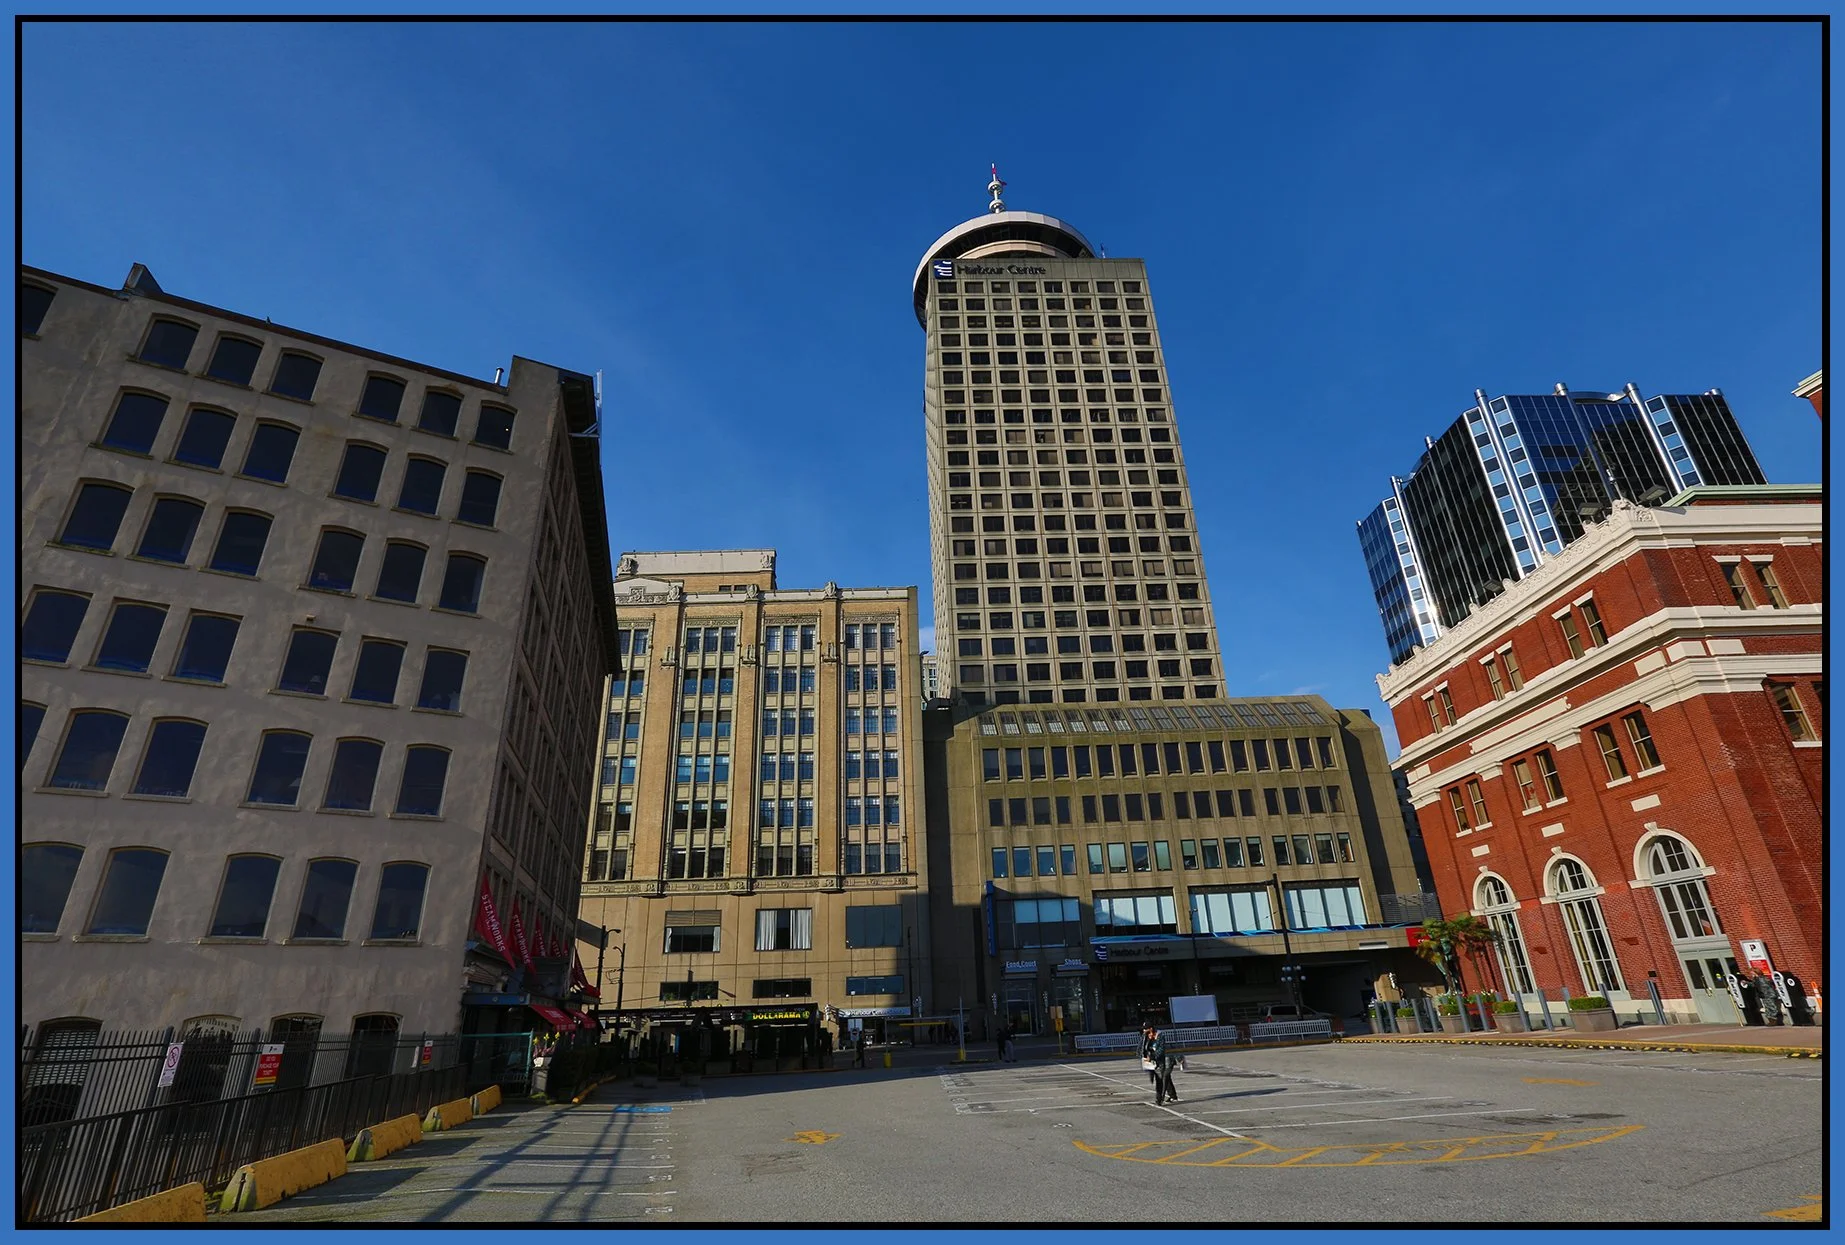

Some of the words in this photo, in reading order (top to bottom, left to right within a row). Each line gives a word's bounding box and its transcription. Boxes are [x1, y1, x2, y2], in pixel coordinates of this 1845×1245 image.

[957, 264, 1004, 275] Harbour
[1007, 264, 1047, 275] Centre
[480, 893, 506, 953] STEAMWORKS
[1110, 947, 1142, 957] Harbour
[1143, 945, 1170, 956] Centre
[752, 1011, 801, 1020] DOLLARAMA
